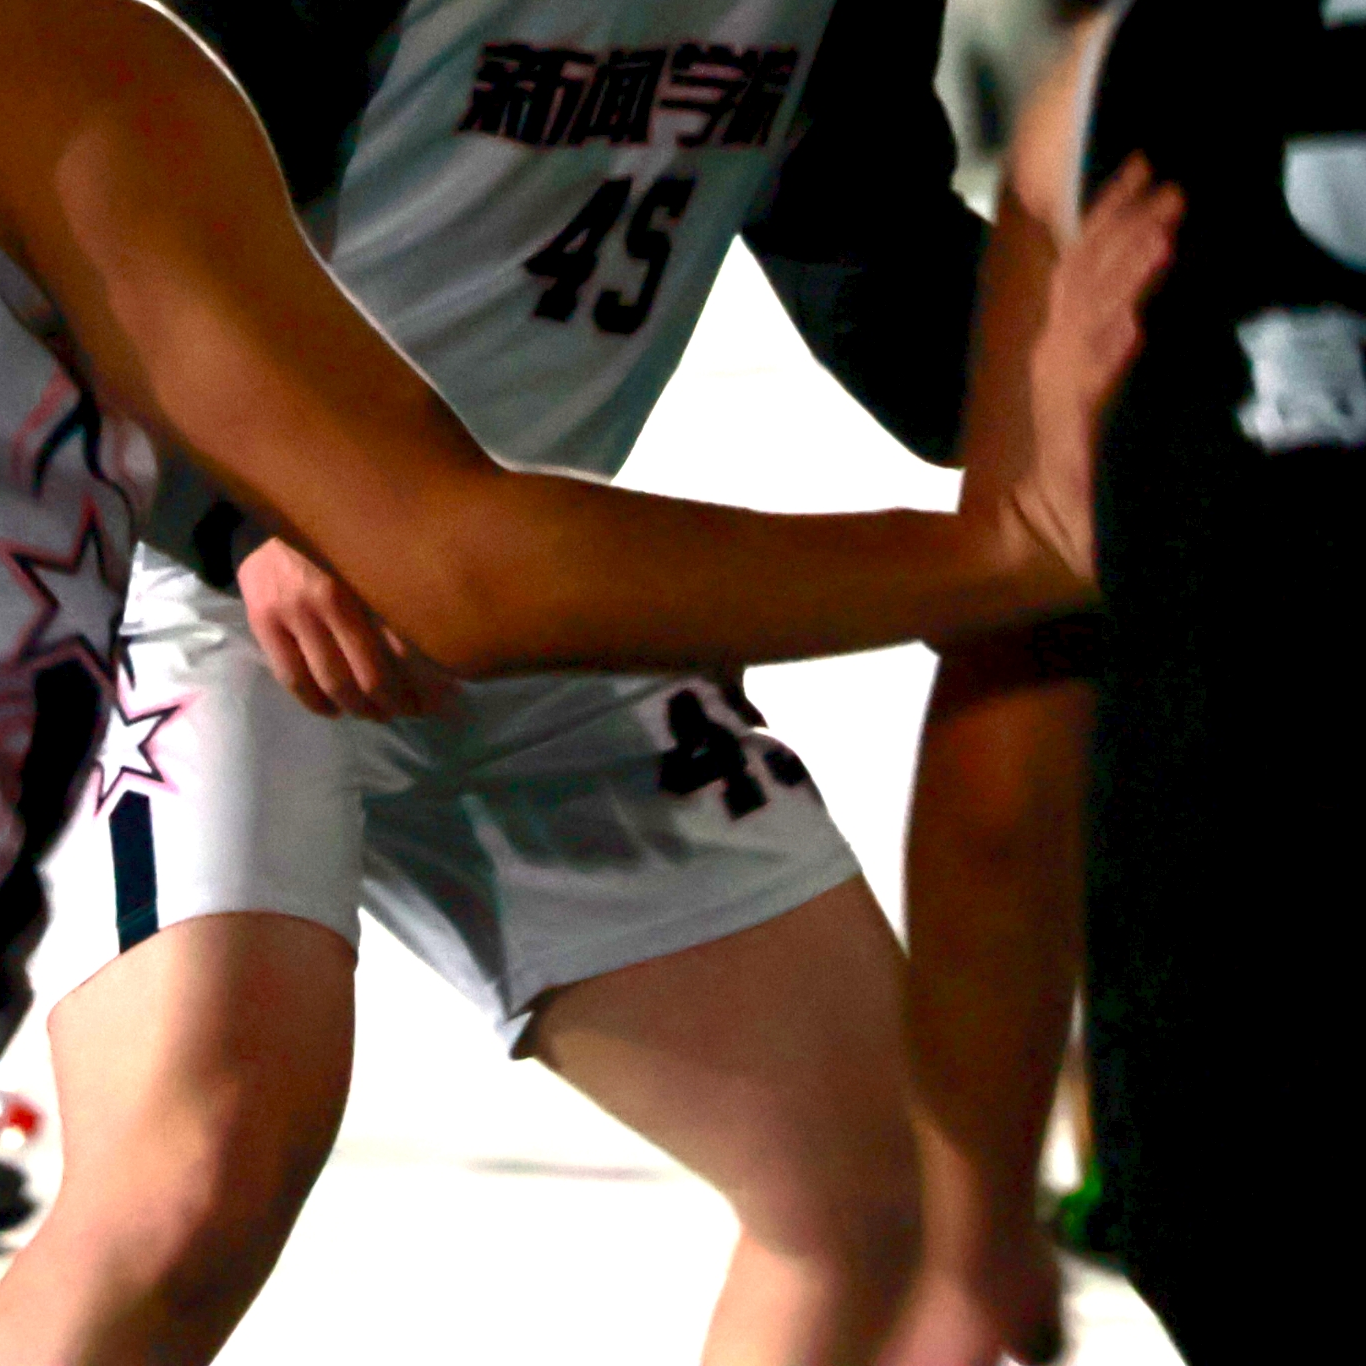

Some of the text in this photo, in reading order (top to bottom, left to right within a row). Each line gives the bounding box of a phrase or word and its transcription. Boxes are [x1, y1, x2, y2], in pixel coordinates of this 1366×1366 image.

[453, 42, 799, 148] 新闻学院
[524, 177, 696, 335] 45
